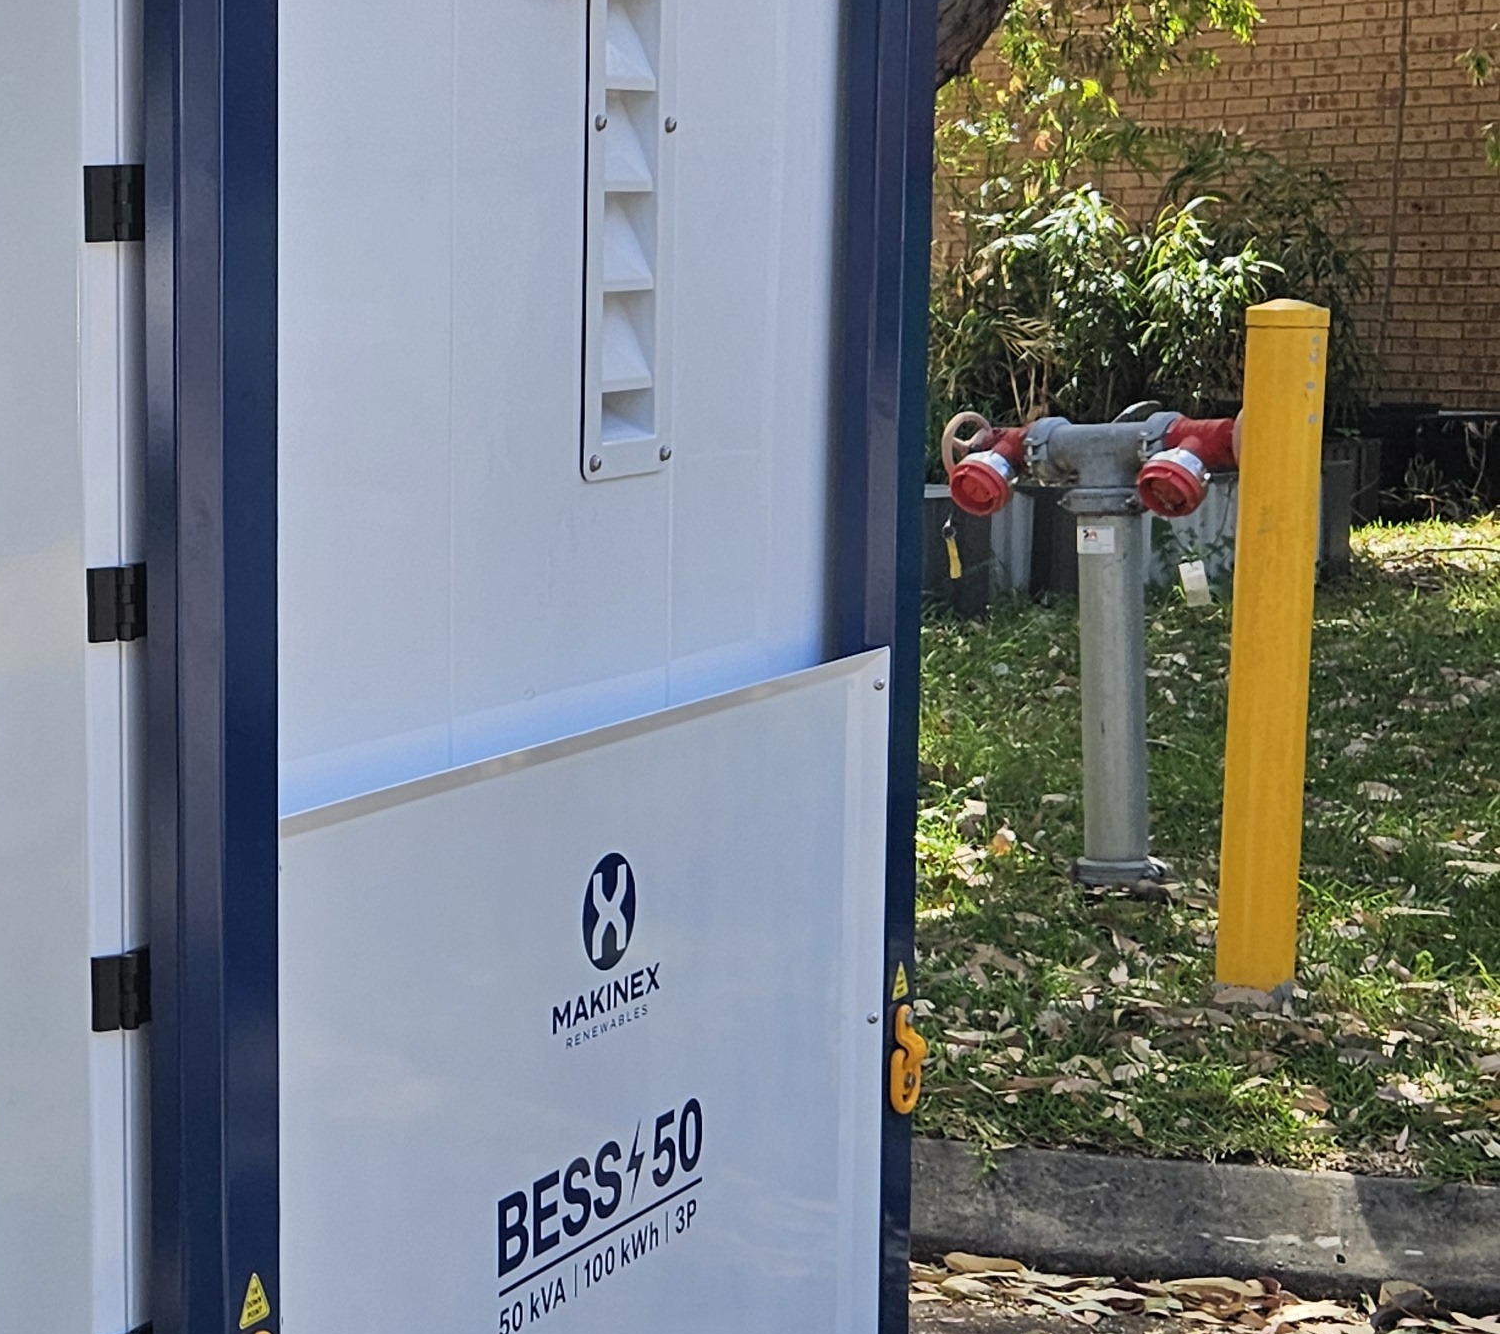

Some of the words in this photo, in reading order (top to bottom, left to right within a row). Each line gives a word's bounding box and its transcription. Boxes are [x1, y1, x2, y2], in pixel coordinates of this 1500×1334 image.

[553, 962, 660, 1035] MAKINEX
[565, 1004, 649, 1050] RENEWABLES
[497, 1141, 622, 1279] BESS
[652, 1098, 703, 1188] 50
[530, 1277, 566, 1323] kVA
[584, 1246, 615, 1288] 100
[621, 1221, 660, 1267] kWh
[675, 1199, 697, 1235] 3P
